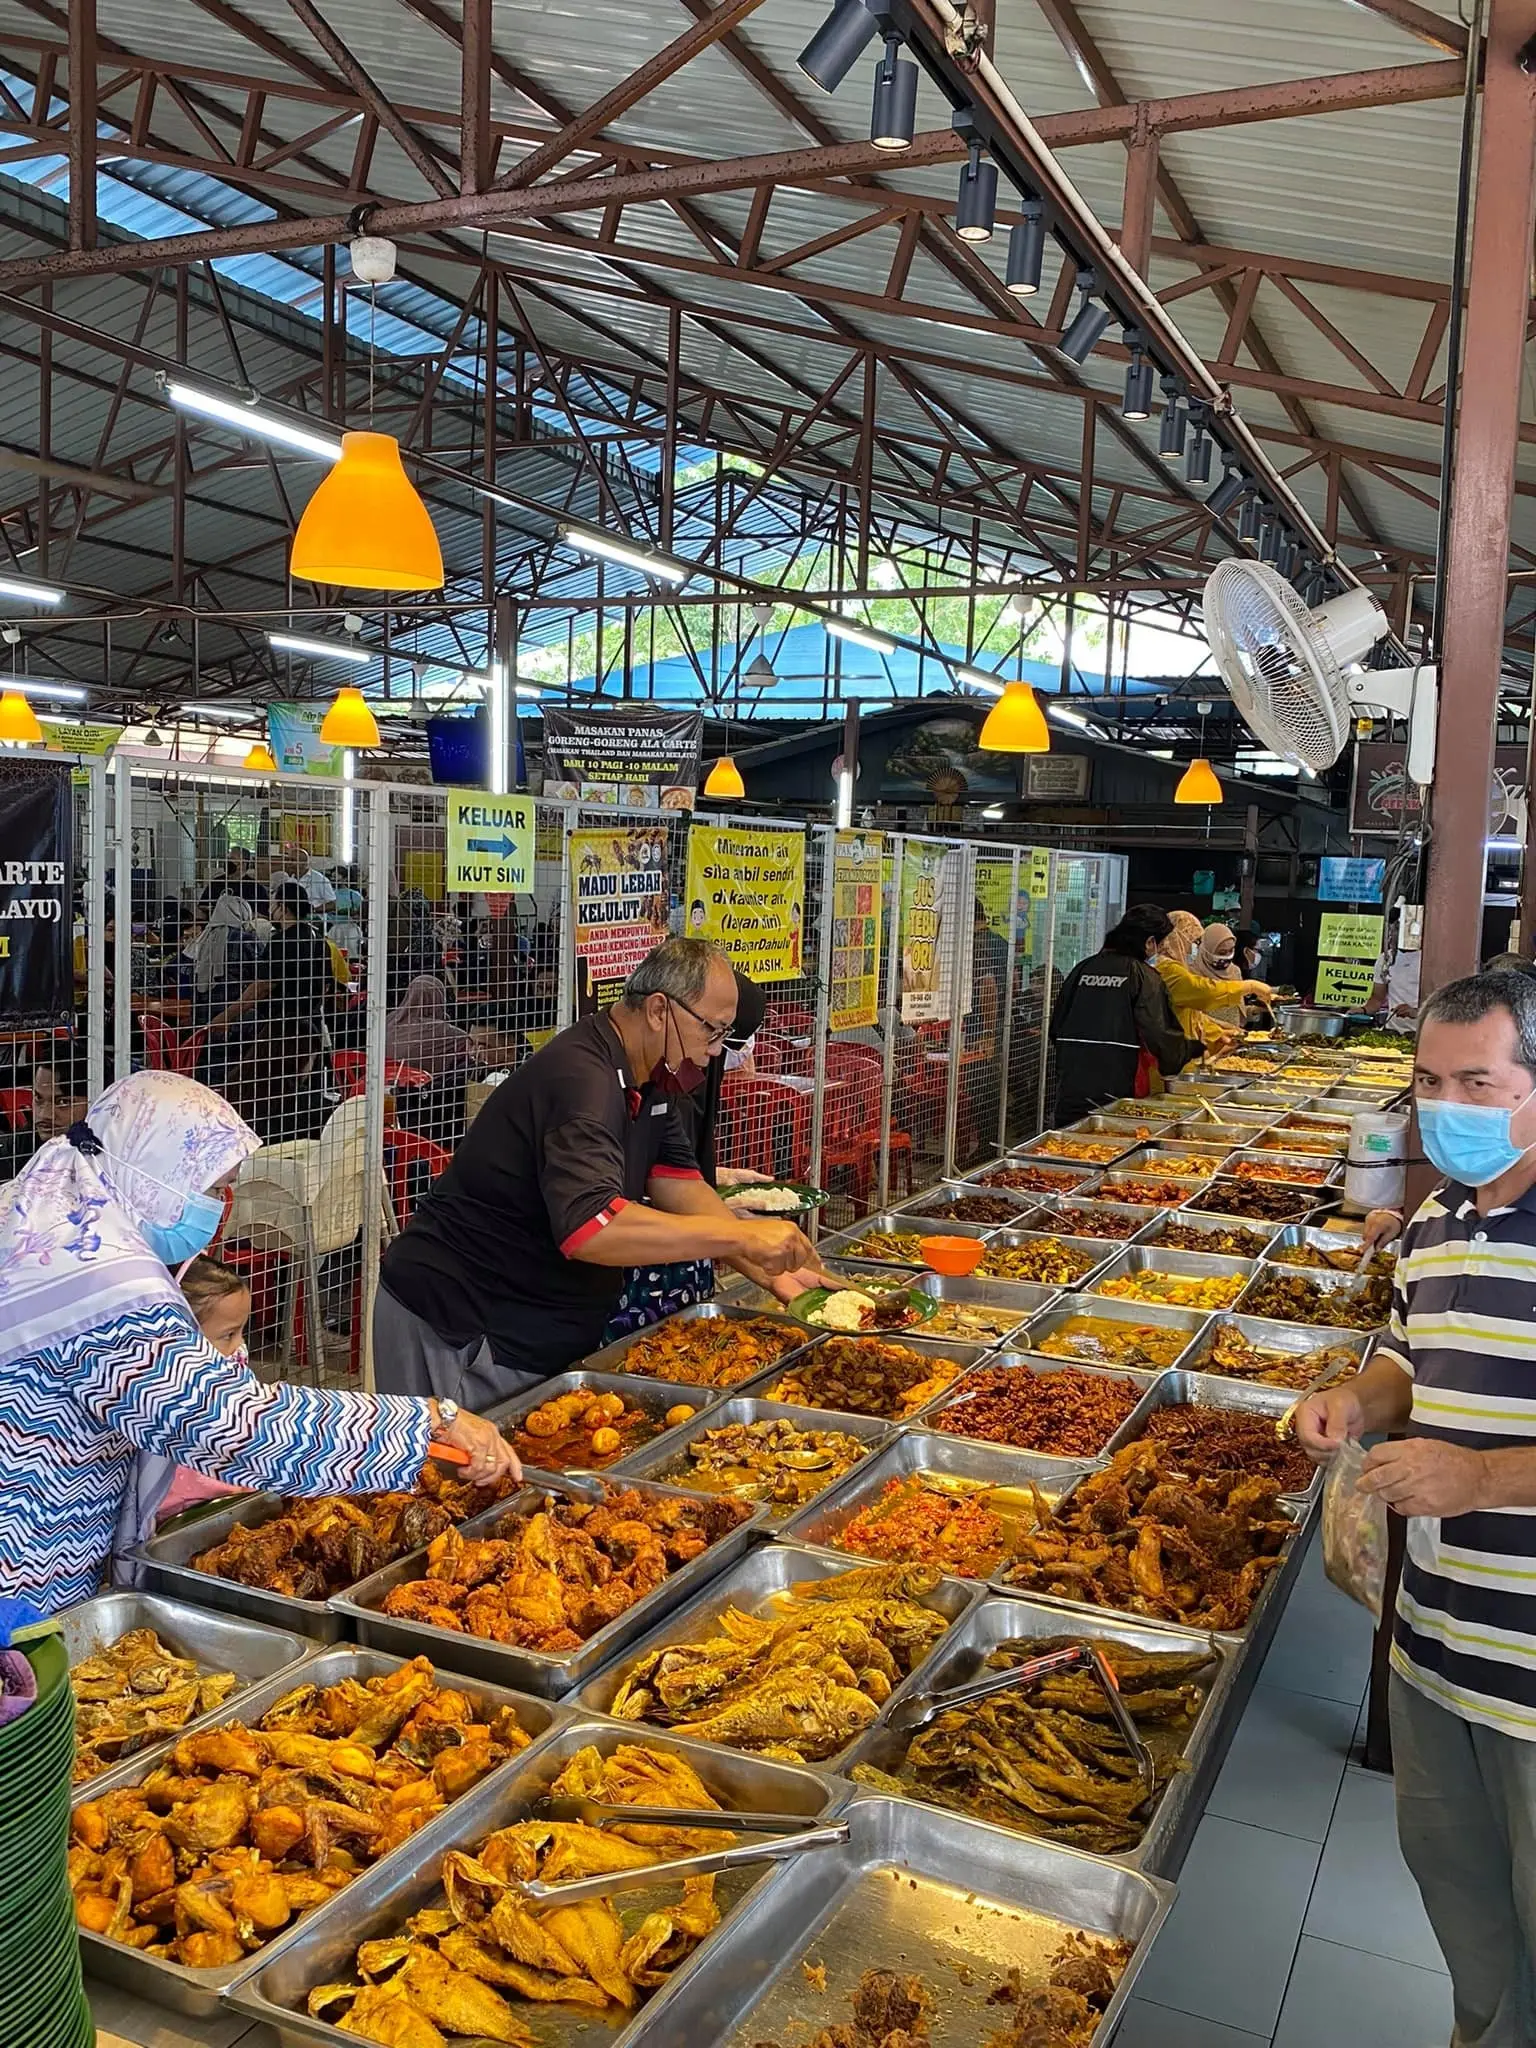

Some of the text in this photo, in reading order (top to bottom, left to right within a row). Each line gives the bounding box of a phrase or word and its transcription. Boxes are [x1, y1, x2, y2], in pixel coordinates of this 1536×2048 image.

[574, 726, 625, 737] MASAKAN
[548, 736, 697, 749] GORENG-GORENG ALA CARTE
[563, 759, 585, 768] DARI
[588, 760, 597, 768] 10
[600, 761, 623, 770] PAGI
[642, 763, 679, 771] MALAM
[588, 772, 650, 782] SETIAP HARI
[458, 805, 525, 829] KELUAR
[458, 865, 525, 883] IKUT SINI
[703, 864, 730, 880] sila
[578, 872, 661, 897] MADU LEBAH
[913, 875, 936, 906] JUS
[578, 900, 640, 924] KELULUT
[590, 924, 651, 940] ANDA MEMPUNYAI
[609, 938, 639, 952] KENCING
[588, 953, 623, 967] MASALAH
[752, 958, 784, 973] KASIH.
[592, 965, 626, 978] MASALAH
[1325, 968, 1374, 982] KELUAR
[1078, 974, 1128, 988] FOXDRY
[1322, 993, 1348, 1003] IKUT
